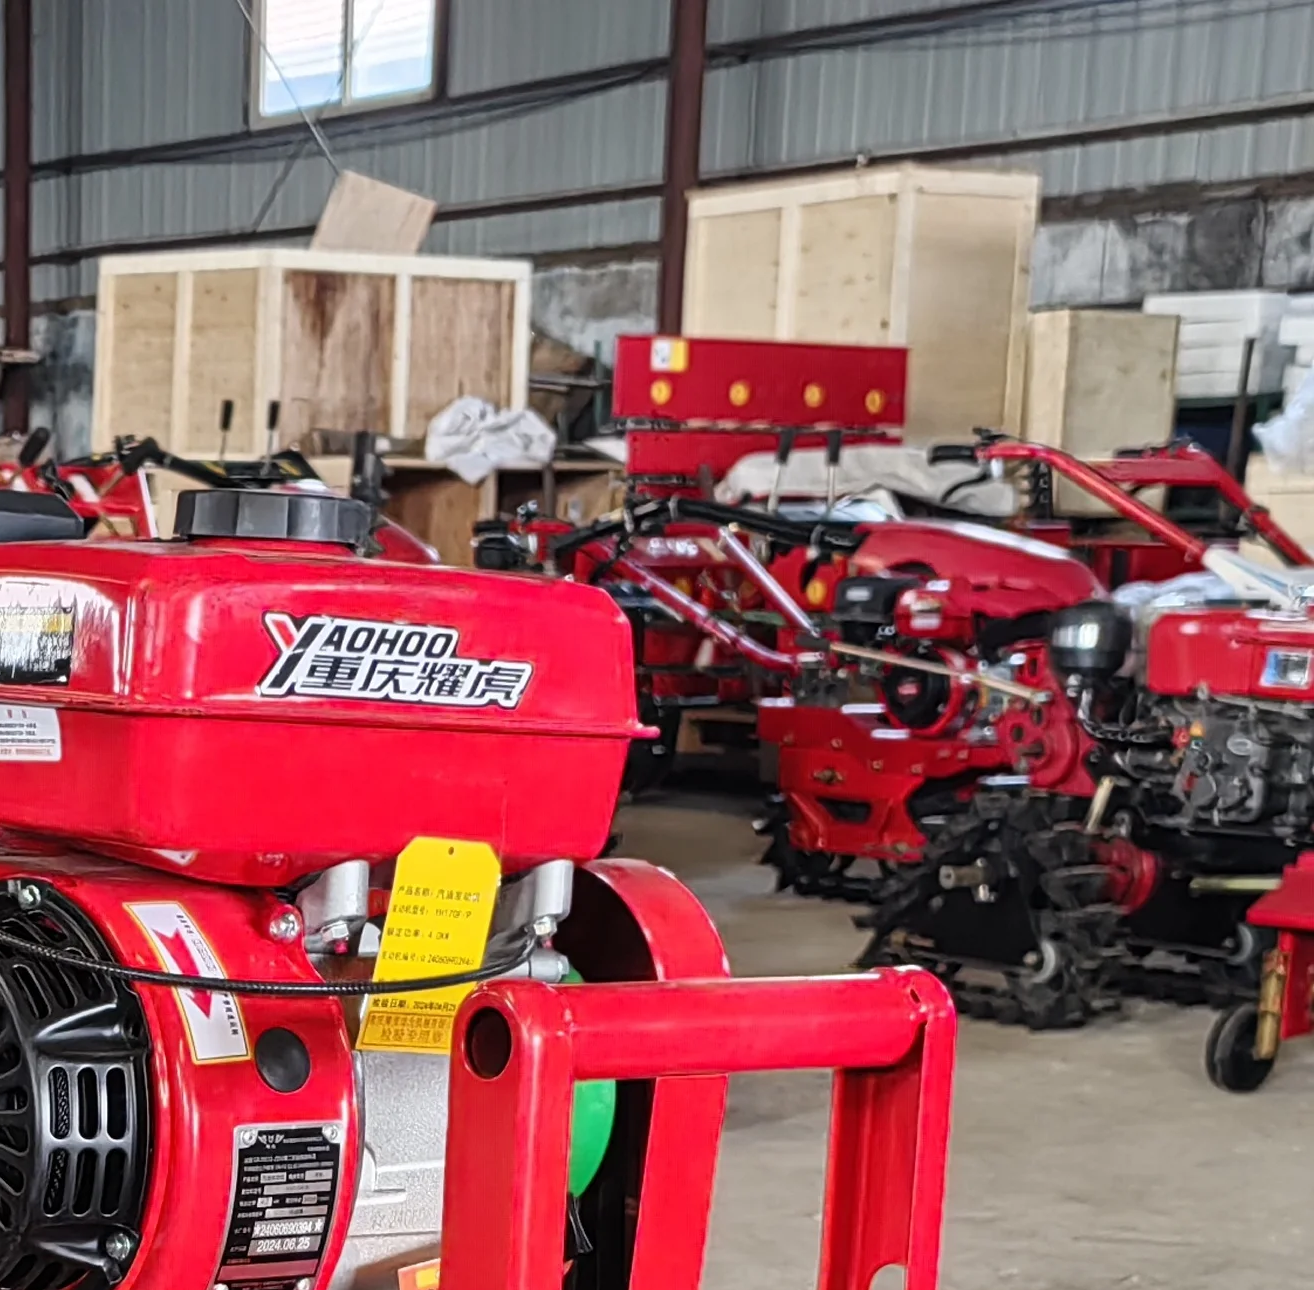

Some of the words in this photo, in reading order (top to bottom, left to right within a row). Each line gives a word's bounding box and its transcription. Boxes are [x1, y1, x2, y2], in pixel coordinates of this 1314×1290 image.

[263, 612, 455, 690] YAOHOO
[299, 654, 526, 700] 重庆耀虎
[257, 1237, 310, 1252] 2024.06.25
